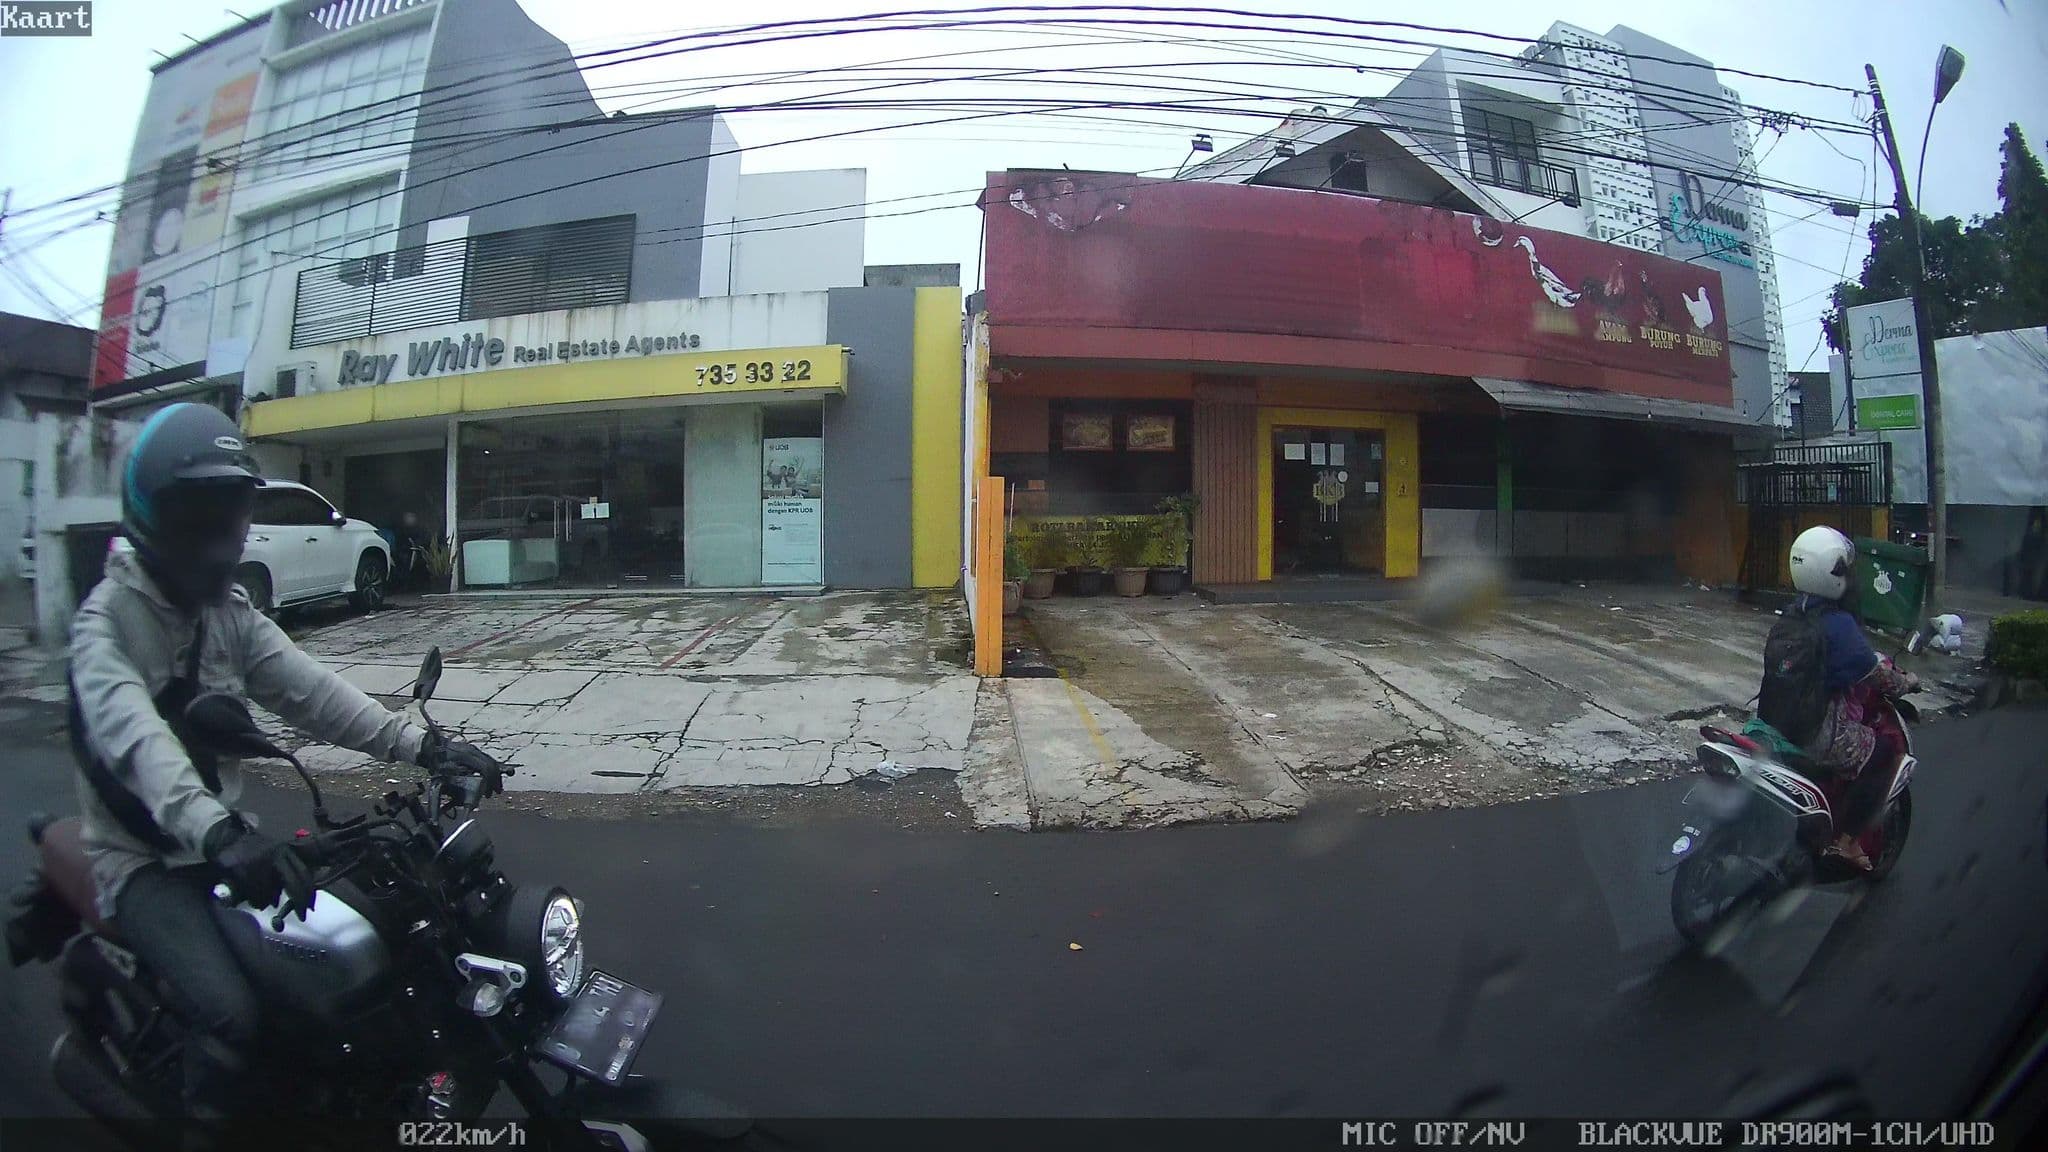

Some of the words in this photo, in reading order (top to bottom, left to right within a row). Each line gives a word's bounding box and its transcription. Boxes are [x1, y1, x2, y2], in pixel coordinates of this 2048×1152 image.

[514, 342, 552, 363] Real
[557, 337, 620, 360] Estate
[625, 331, 701, 356] Agents
[1639, 326, 1681, 343] BURUNG
[1685, 333, 1723, 351] BURUNG
[337, 349, 398, 385] Ray
[407, 332, 505, 377] White
[695, 363, 738, 387] 735
[745, 361, 774, 384] 33
[781, 359, 812, 383] 22
